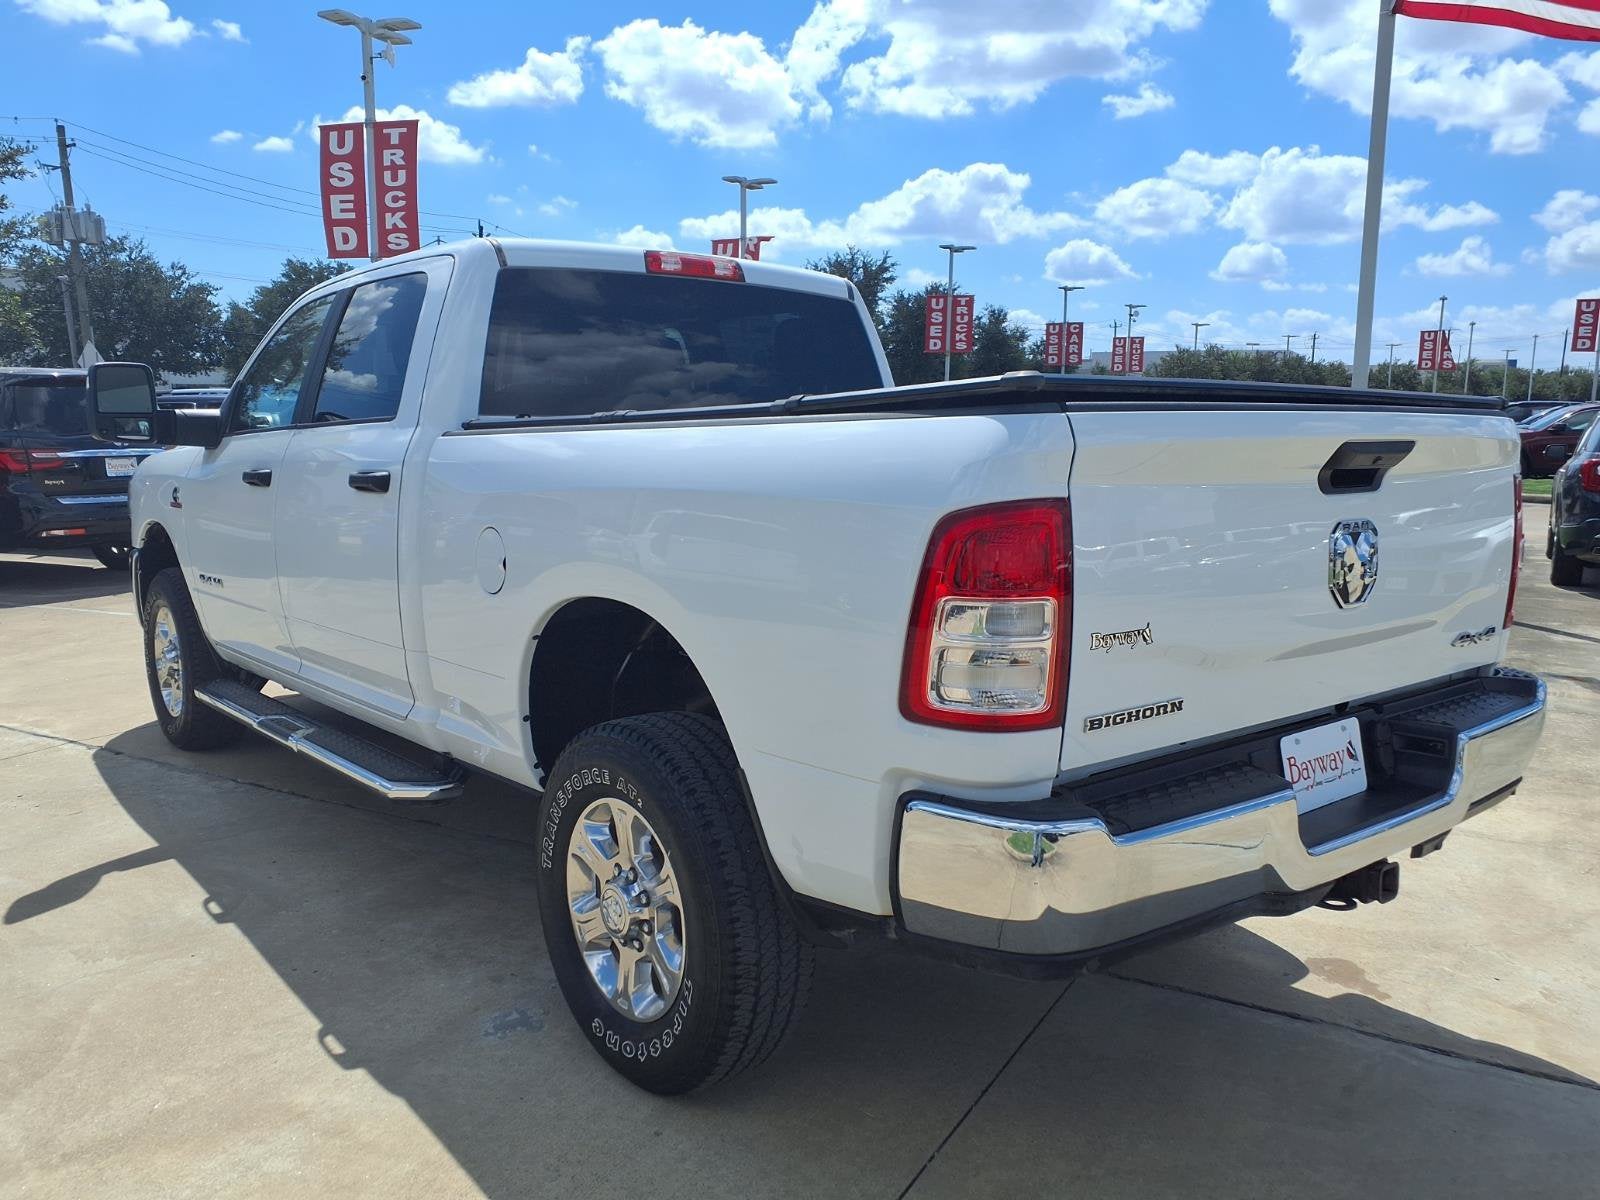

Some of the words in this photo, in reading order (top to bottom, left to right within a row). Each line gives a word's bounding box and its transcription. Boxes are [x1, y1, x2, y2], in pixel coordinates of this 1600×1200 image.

[328, 129, 359, 251] USED
[382, 127, 410, 250] TRUCKS
[929, 298, 944, 350] USED
[955, 297, 970, 350] TRUCKS
[1047, 324, 1059, 364] USED
[1068, 324, 1080, 363] CARS
[1576, 301, 1596, 349] USED
[1113, 338, 1124, 372] USED
[1131, 338, 1142, 371] TRUCKS
[1420, 332, 1435, 369] USED
[1341, 520, 1370, 532] RAM
[1090, 628, 1143, 654] Bayway
[1086, 699, 1184, 732] BIGHORN
[1286, 749, 1345, 791] Bayway
[541, 767, 611, 870] TRANSFORCE
[592, 978, 693, 1063] Firestone
